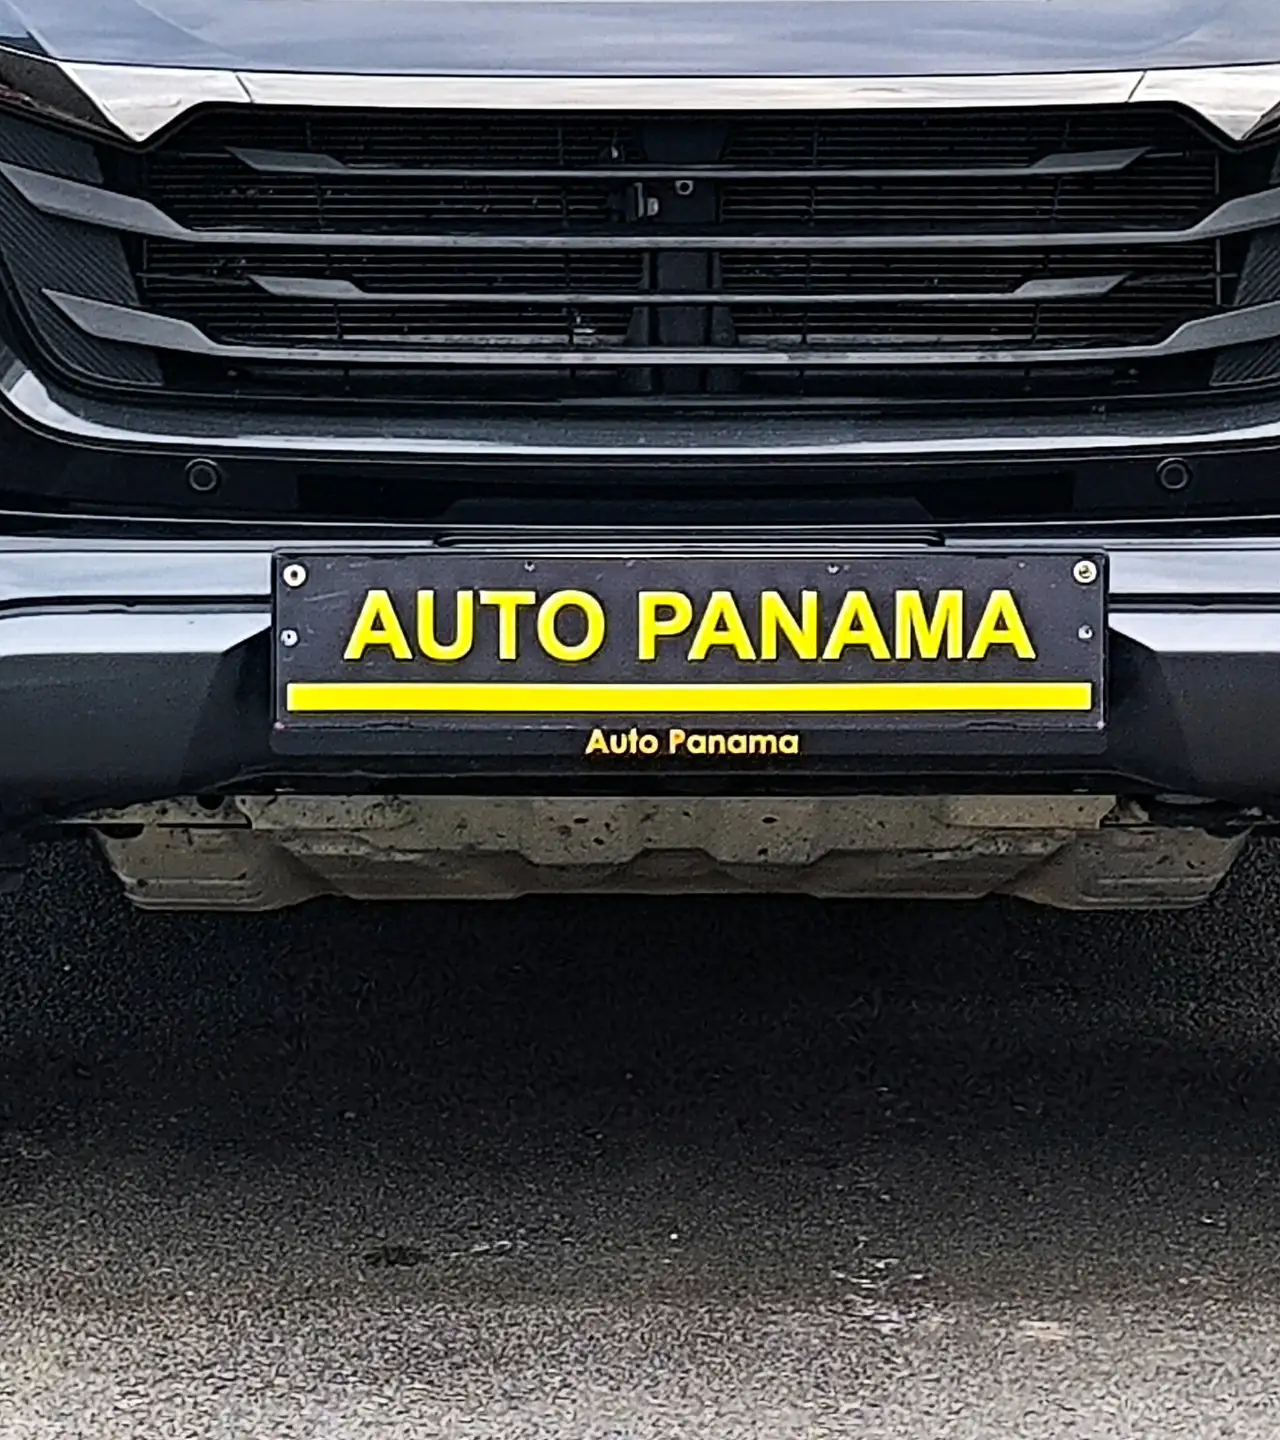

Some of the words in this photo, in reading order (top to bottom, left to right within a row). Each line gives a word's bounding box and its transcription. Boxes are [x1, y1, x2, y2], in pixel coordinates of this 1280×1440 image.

[342, 587, 607, 663] AUTO
[637, 586, 1038, 662] PANAMA
[584, 727, 660, 755] Auto
[669, 728, 800, 755] Panama
